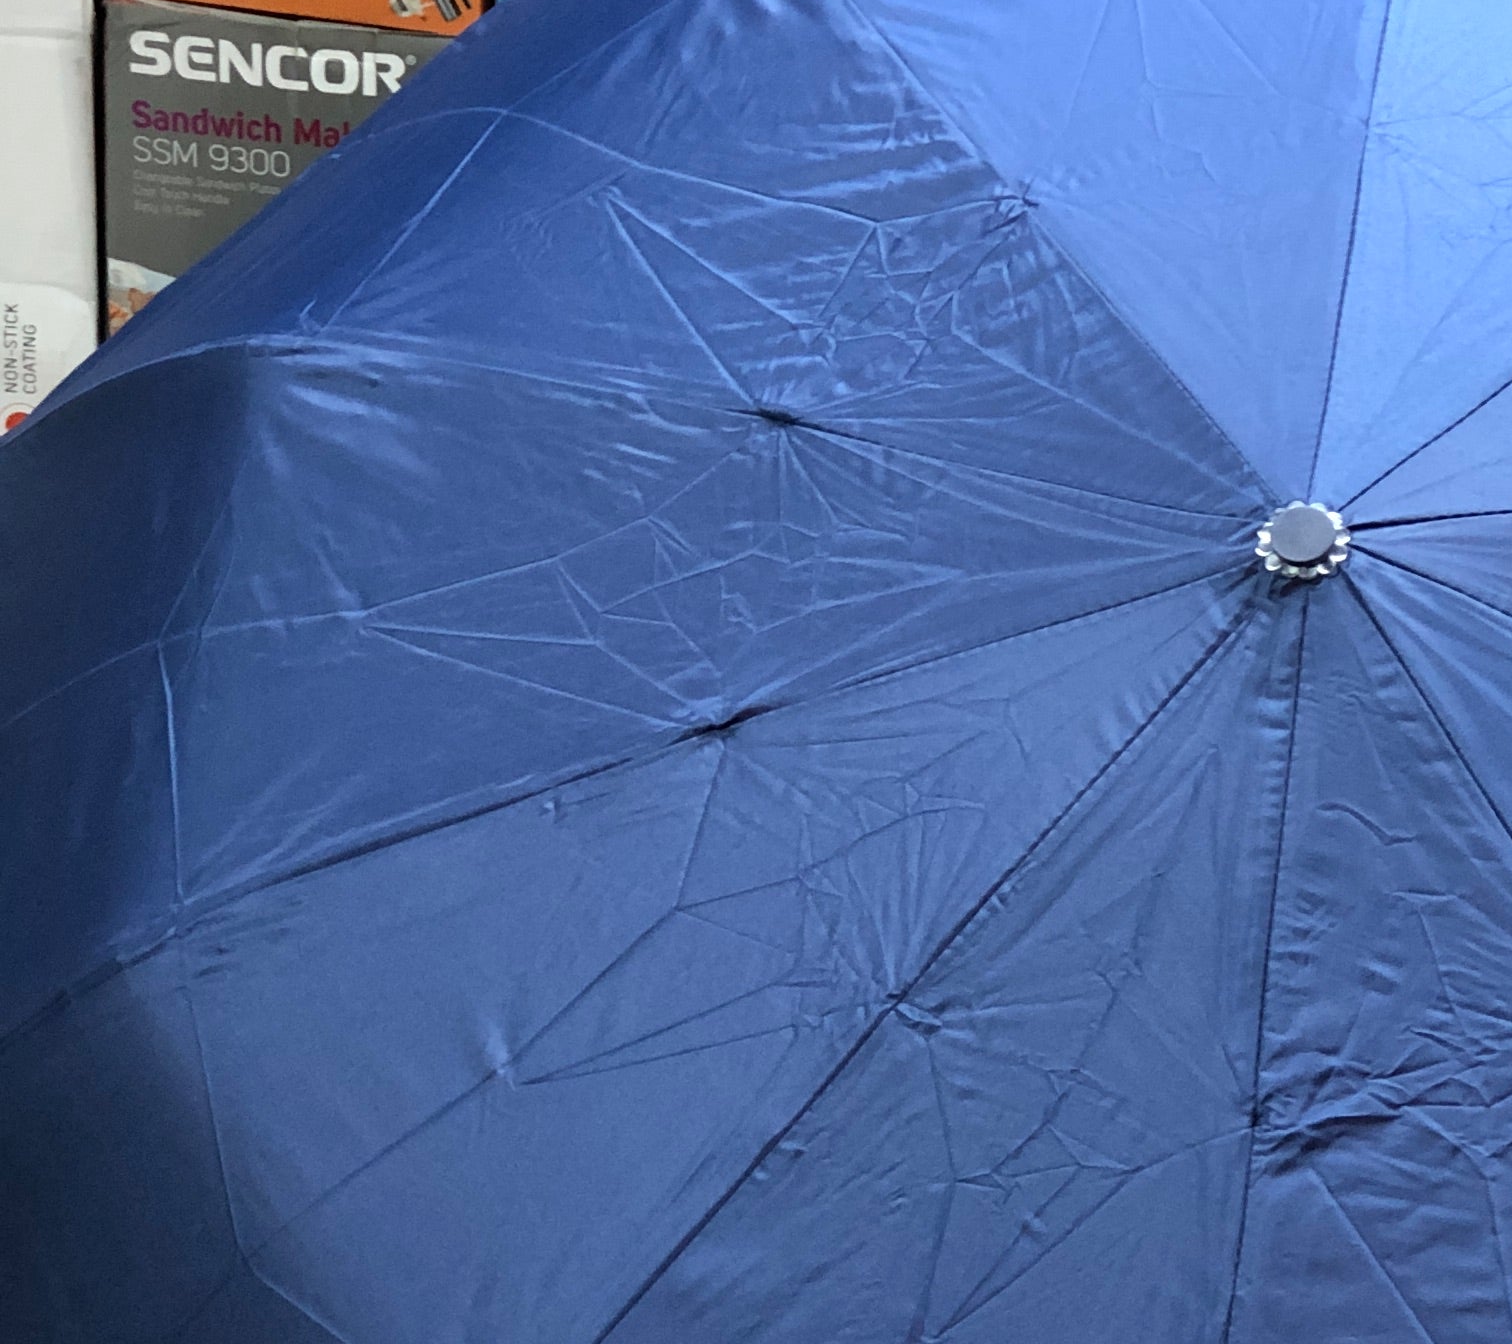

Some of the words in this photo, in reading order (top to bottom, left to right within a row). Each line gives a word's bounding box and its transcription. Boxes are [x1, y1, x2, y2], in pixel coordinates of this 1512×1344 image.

[128, 29, 408, 98] SENCOR
[131, 98, 284, 145] Sandwich
[132, 135, 200, 168] SSM
[208, 143, 291, 178] 9300
[3, 303, 20, 394] NON-STICK
[22, 323, 38, 395] COATING
